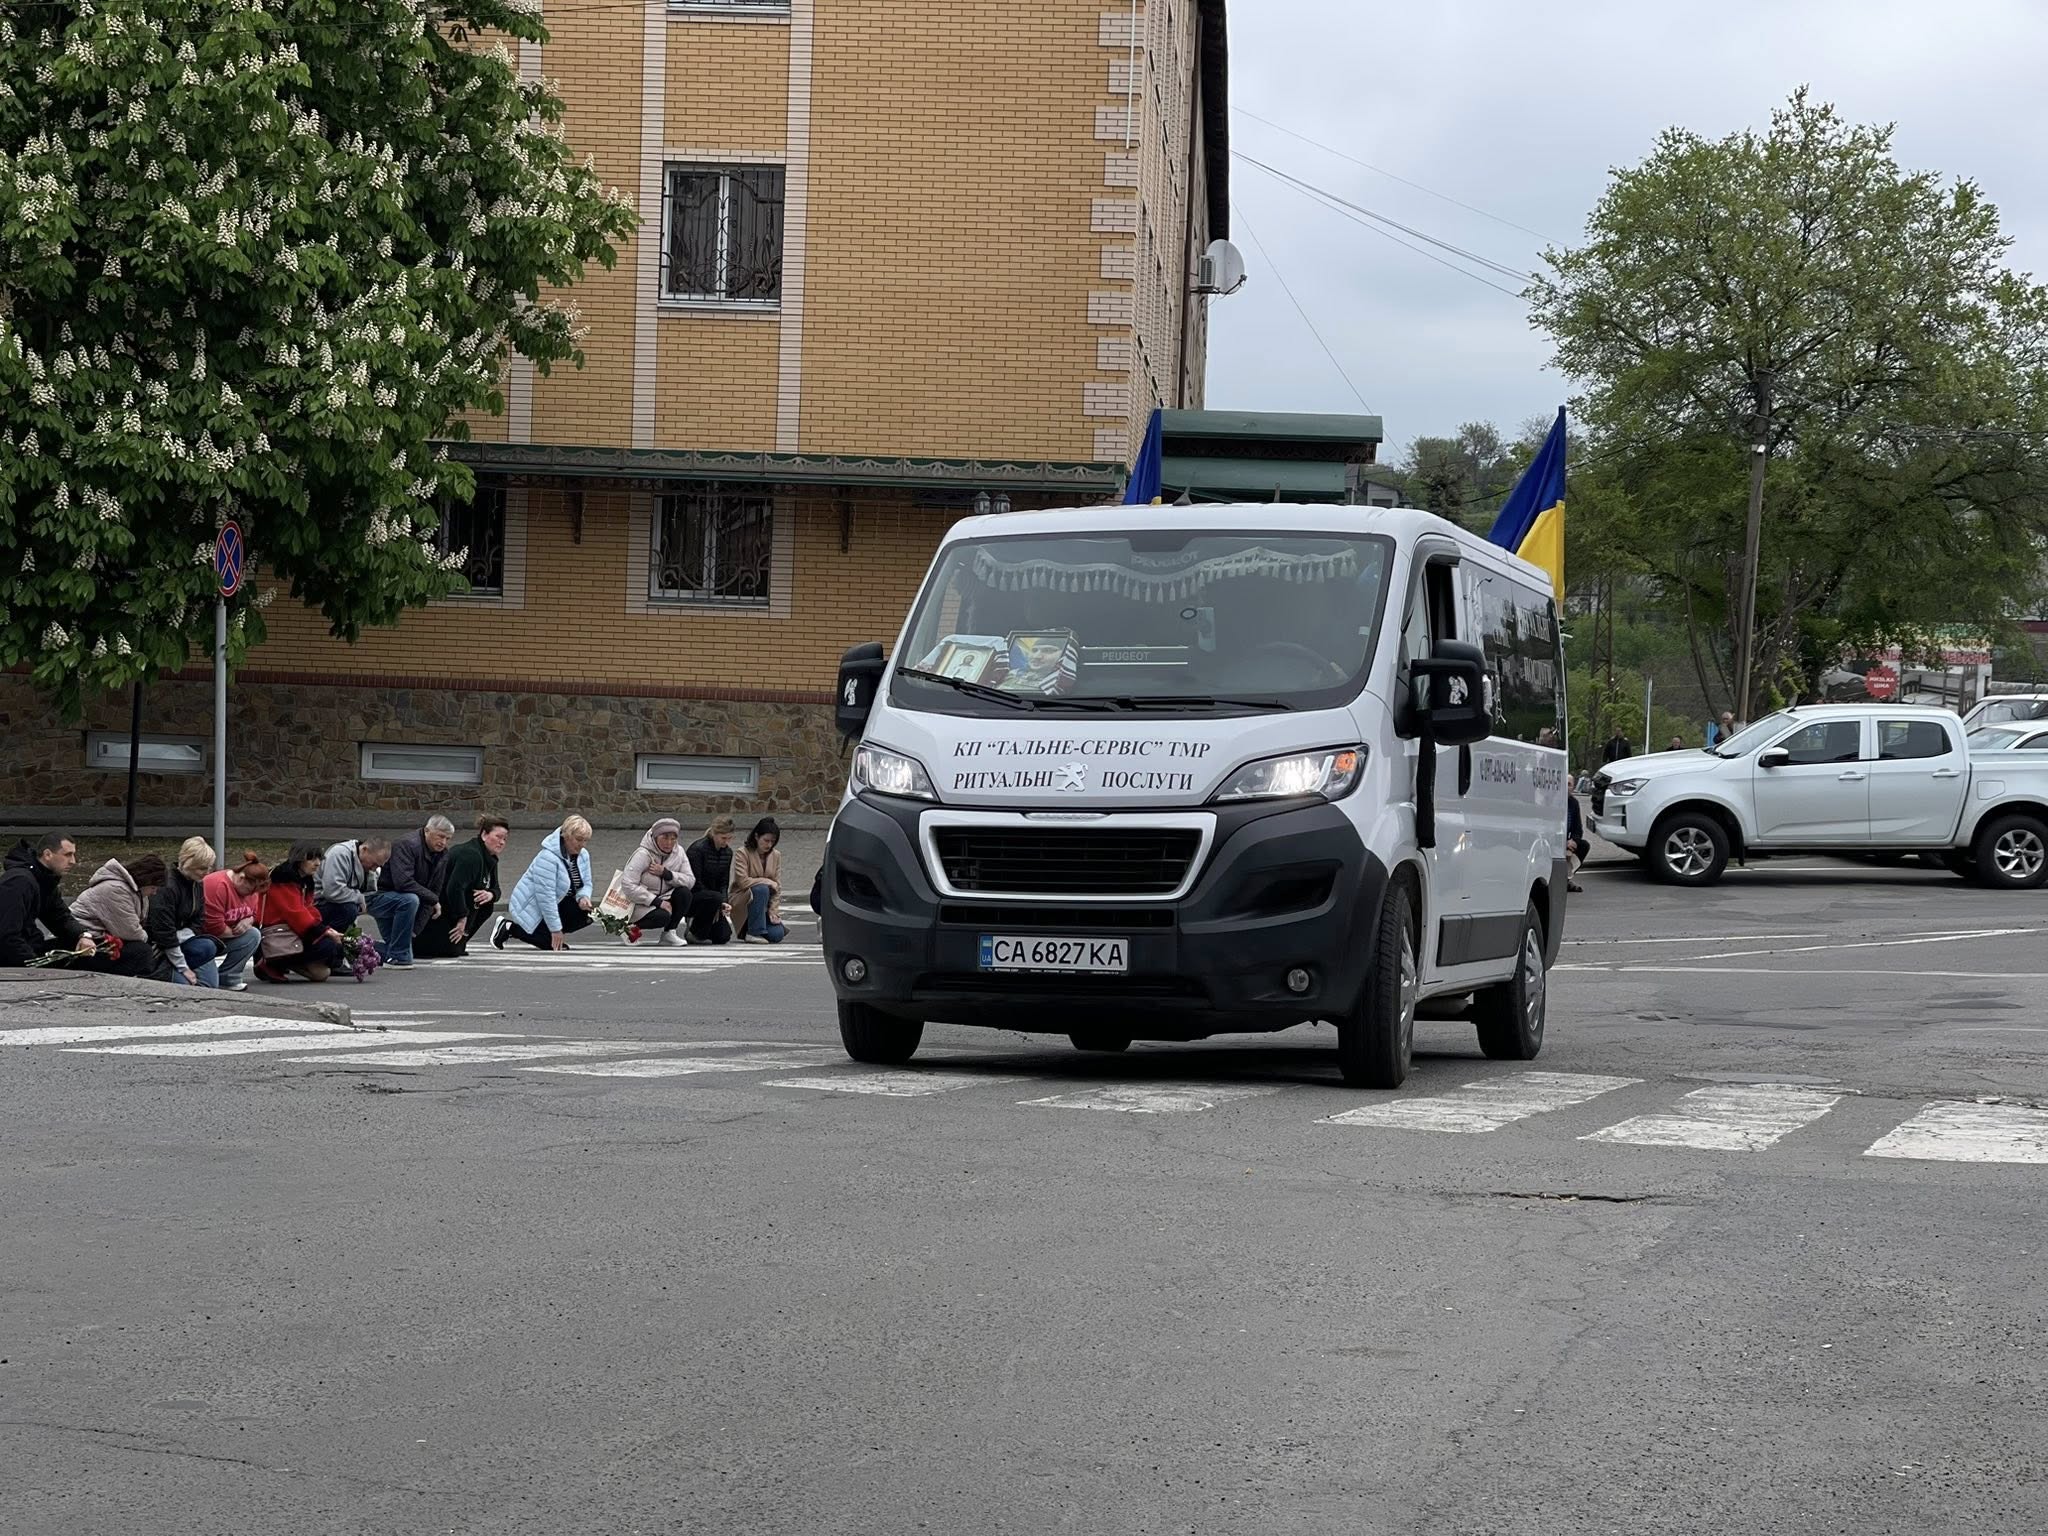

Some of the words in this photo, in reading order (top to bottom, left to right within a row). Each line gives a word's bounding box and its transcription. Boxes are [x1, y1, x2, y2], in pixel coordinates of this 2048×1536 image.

[1102, 651, 1150, 661] PEUGEOT
[953, 741, 982, 757] КП
[1168, 741, 1211, 758] ТМР
[953, 770, 1055, 790] РИТУАЛЬНІ
[1101, 771, 1194, 790] ПОСЛУГИ
